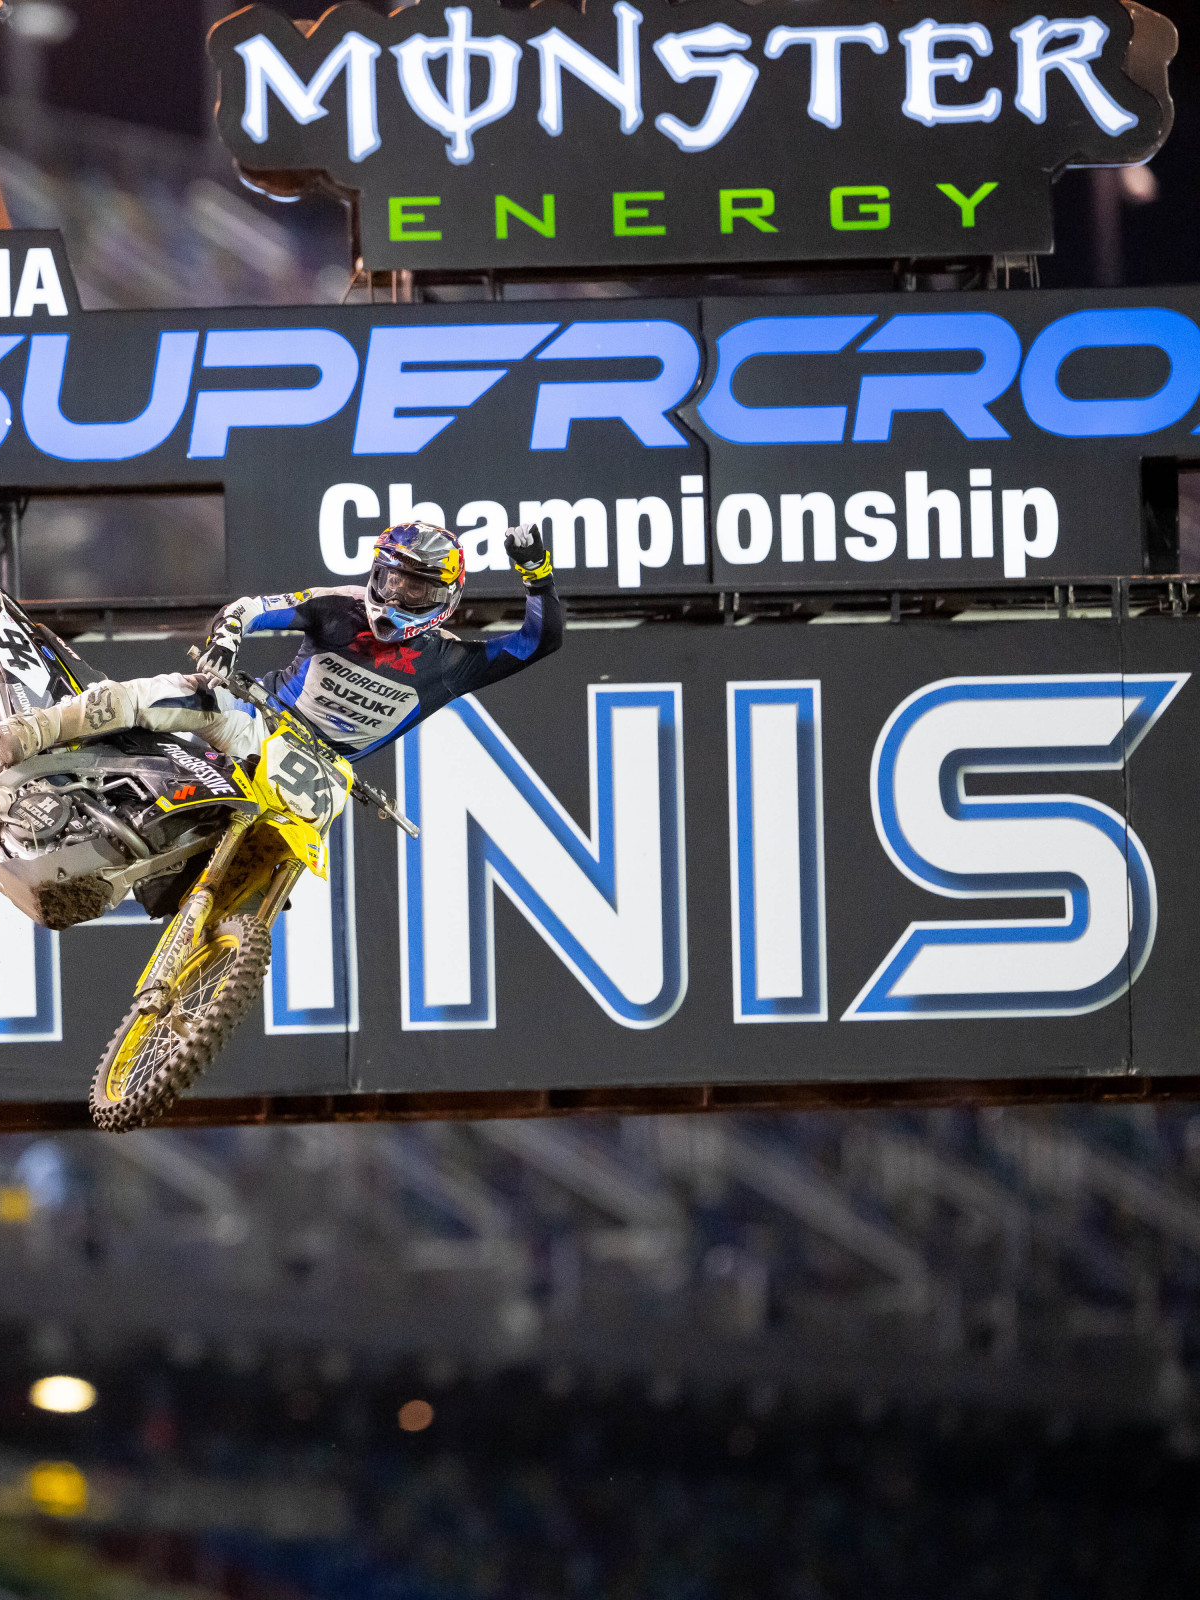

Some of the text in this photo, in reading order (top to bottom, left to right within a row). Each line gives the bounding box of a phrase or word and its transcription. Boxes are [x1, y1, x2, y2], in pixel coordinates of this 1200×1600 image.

[234, 1, 1139, 165] MONSTER
[388, 182, 999, 241] ENERGY
[318, 656, 415, 703] PROGRESSIVE
[320, 677, 397, 717] SUZUKI
[314, 695, 382, 729] ECSTAR
[156, 743, 236, 796] PROGRESSIVE
[269, 750, 335, 817] 94
[19, 800, 55, 827] SUZUKI
[163, 914, 196, 977] DUNLOP
